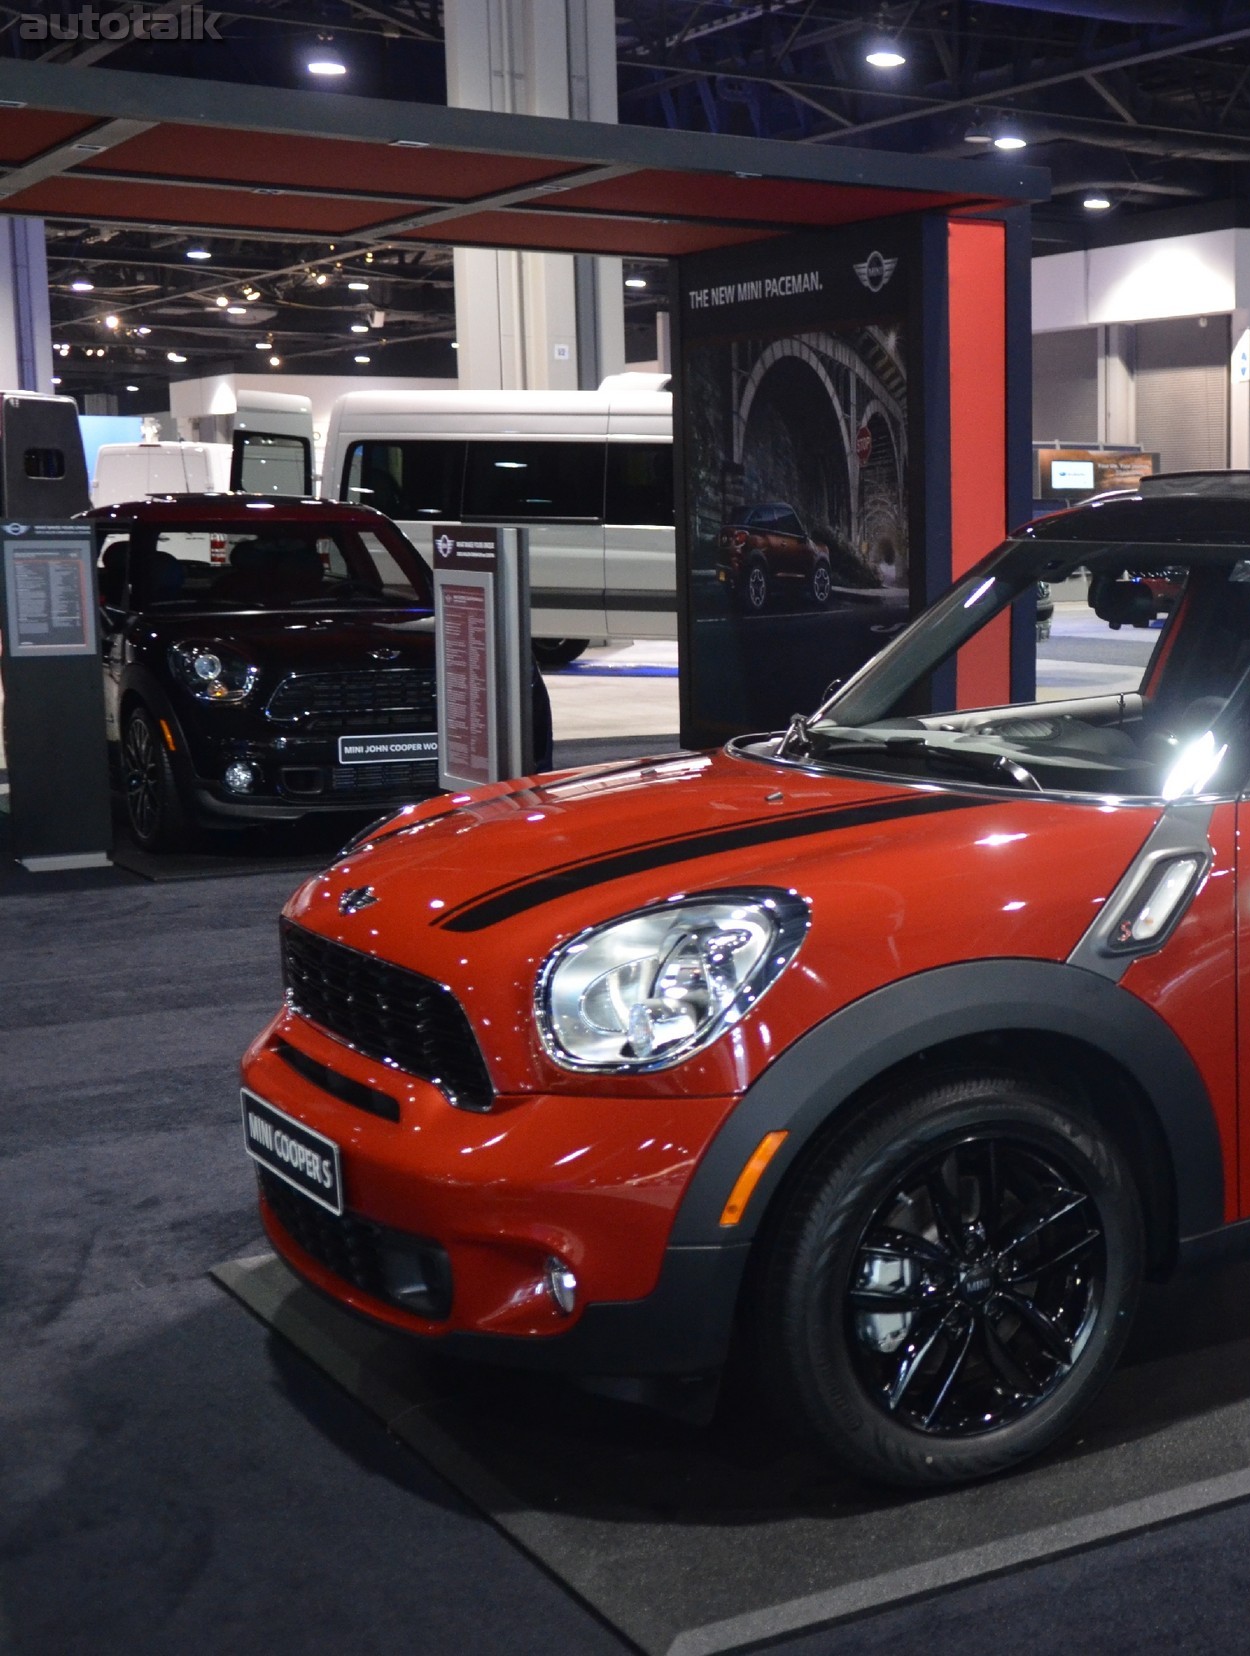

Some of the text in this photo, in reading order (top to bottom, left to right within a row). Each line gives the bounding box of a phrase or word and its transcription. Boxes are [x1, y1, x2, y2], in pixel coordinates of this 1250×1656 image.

[689, 271, 823, 309] THE NEW MINI PACEMAN.
[344, 745, 363, 754] MINI
[365, 744, 389, 753] JOHN
[389, 743, 422, 752] COOPER
[248, 1112, 333, 1188] MINI COOPER S
[966, 1278, 990, 1293] MINI
